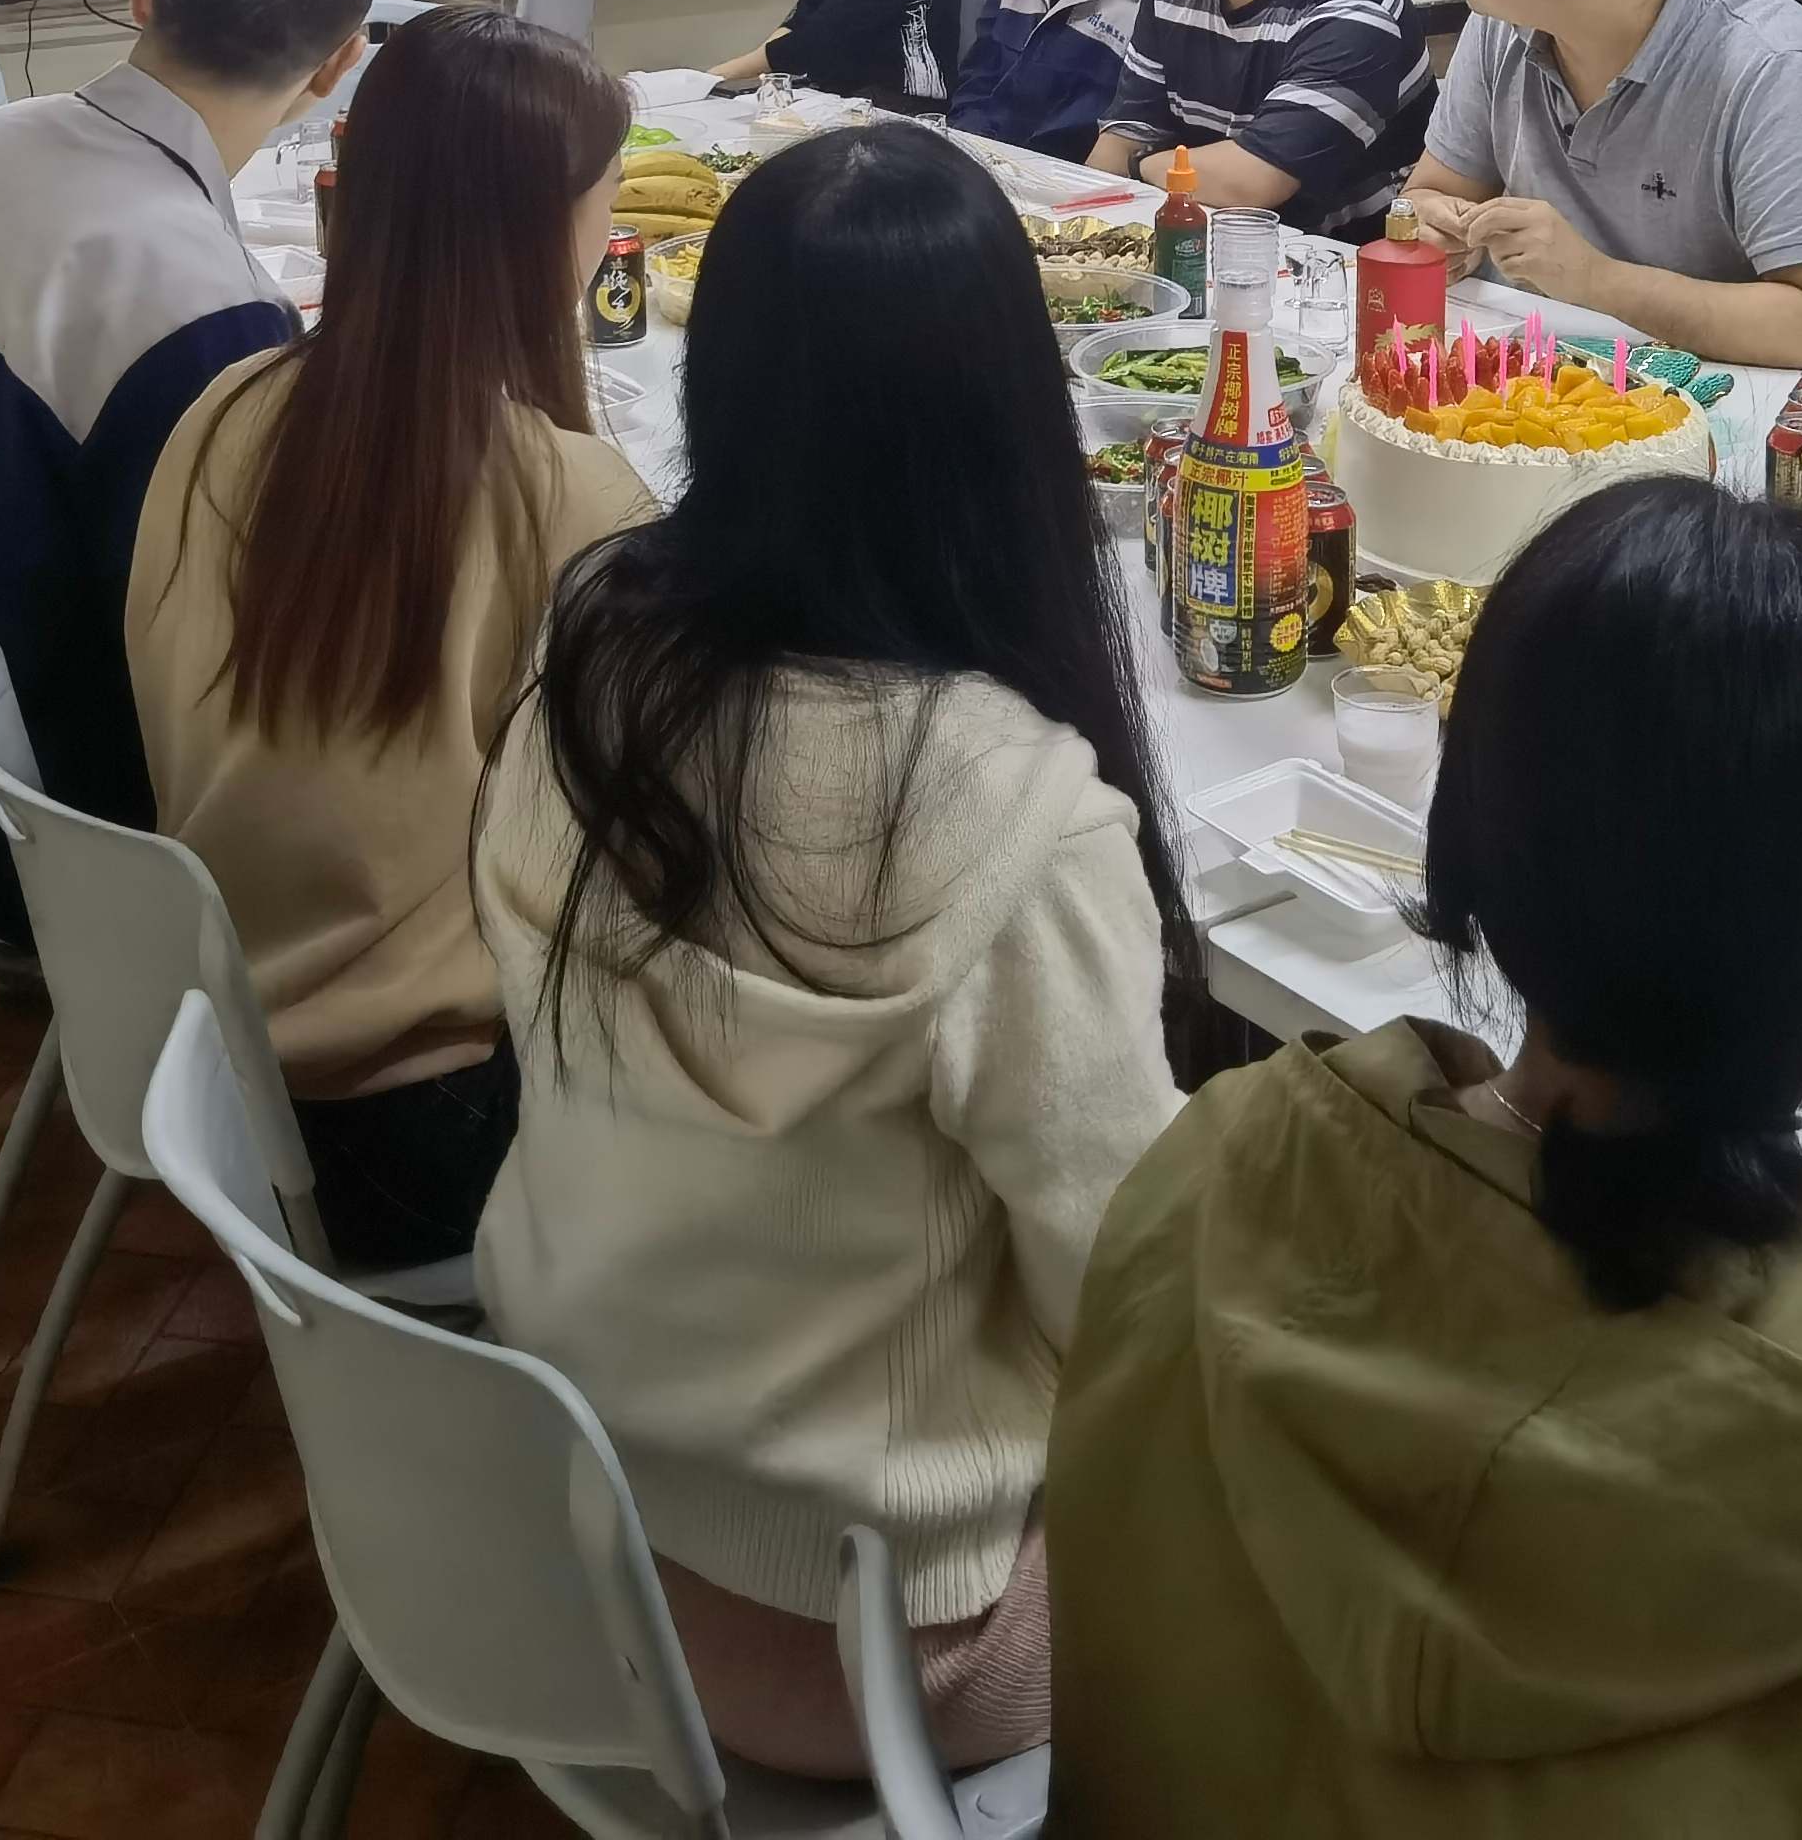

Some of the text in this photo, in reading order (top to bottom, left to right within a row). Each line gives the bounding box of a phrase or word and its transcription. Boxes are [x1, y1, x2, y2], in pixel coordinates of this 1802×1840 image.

[1214, 343, 1242, 438] 正宗椰树牌
[1190, 462, 1247, 488] 正宗椰汁
[1190, 489, 1234, 604] 椰树牌
